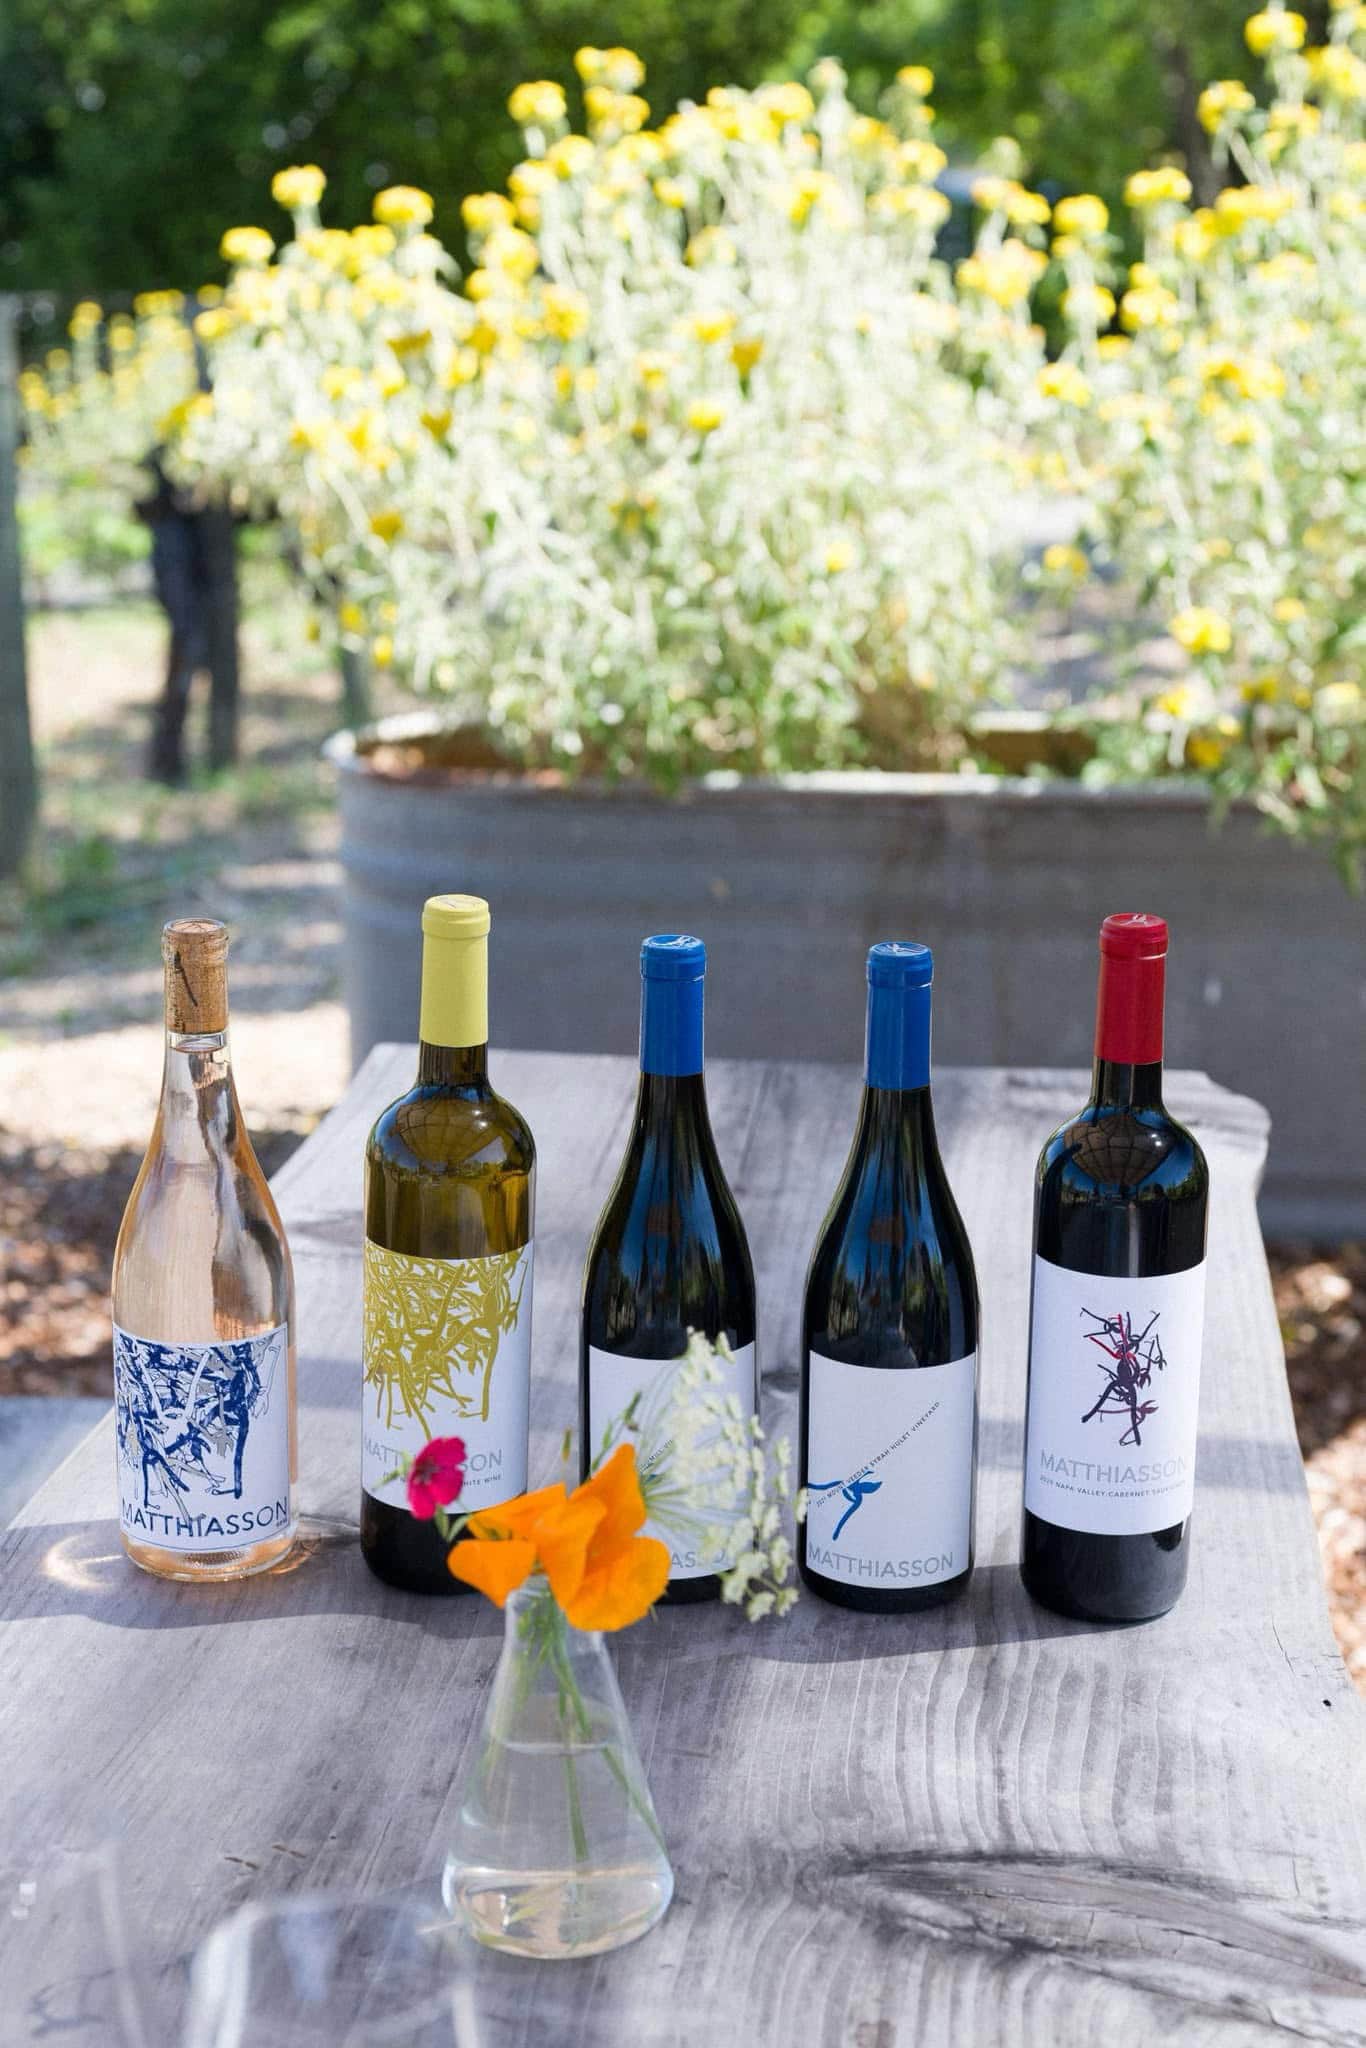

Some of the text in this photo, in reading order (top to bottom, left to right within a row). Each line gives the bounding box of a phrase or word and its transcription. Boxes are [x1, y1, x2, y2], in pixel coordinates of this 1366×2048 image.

[847, 1465, 869, 1484] VEEDER
[870, 1449, 890, 1468] SYRAH
[891, 1432, 911, 1450] HULET
[912, 1401, 941, 1432] VINEYARD
[484, 1474, 502, 1484] WINE
[1039, 1448, 1188, 1484] MATTHIASSON
[1055, 1481, 1075, 1491] NAPA
[122, 1496, 288, 1538] MATTHIASSON
[808, 1541, 954, 1578] MATTHIASSON
